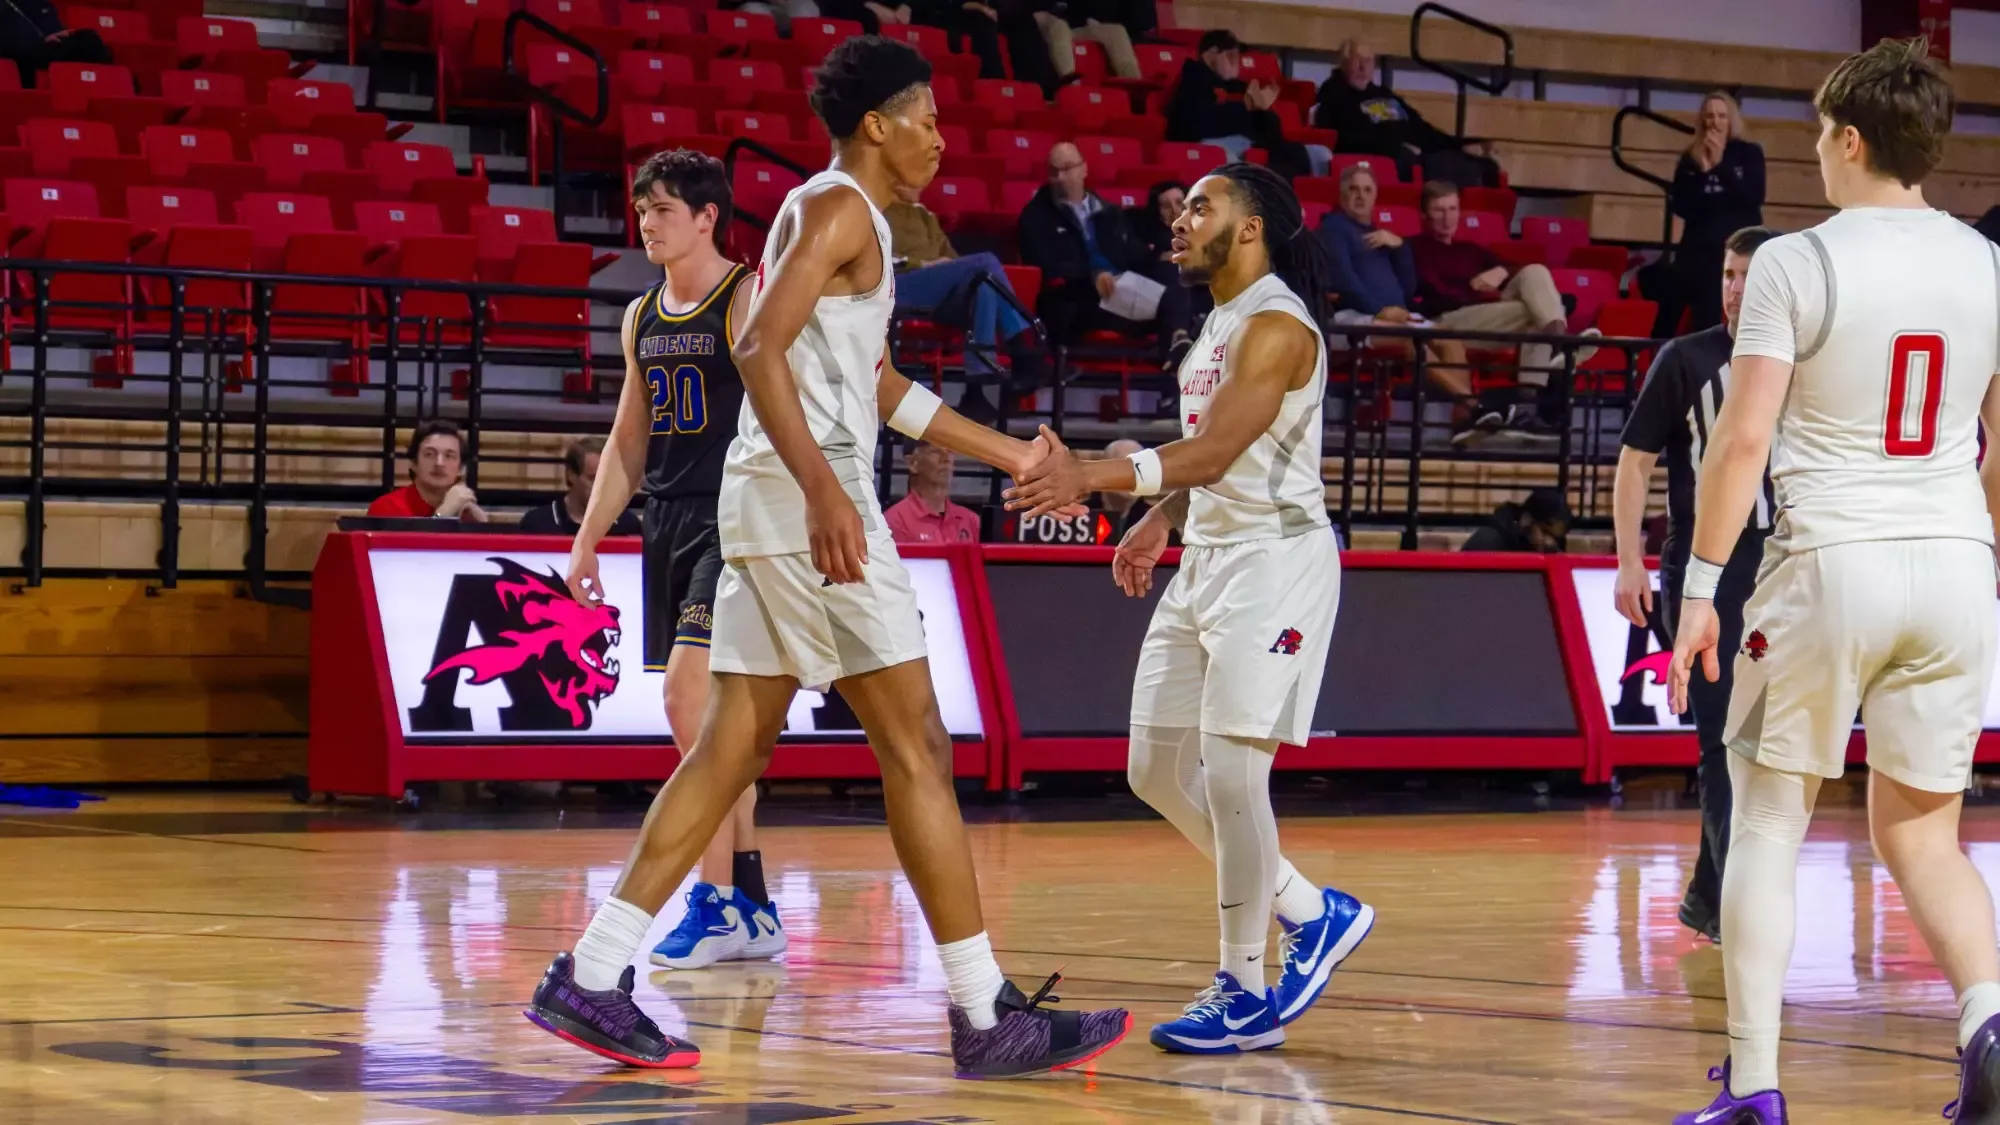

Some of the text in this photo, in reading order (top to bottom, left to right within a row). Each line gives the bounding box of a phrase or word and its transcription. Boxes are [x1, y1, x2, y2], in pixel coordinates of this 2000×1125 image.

[640, 333, 714, 358] WIDENER
[646, 364, 707, 434] 20
[1881, 329, 1949, 460] 0
[1018, 512, 1095, 542] POSS.
